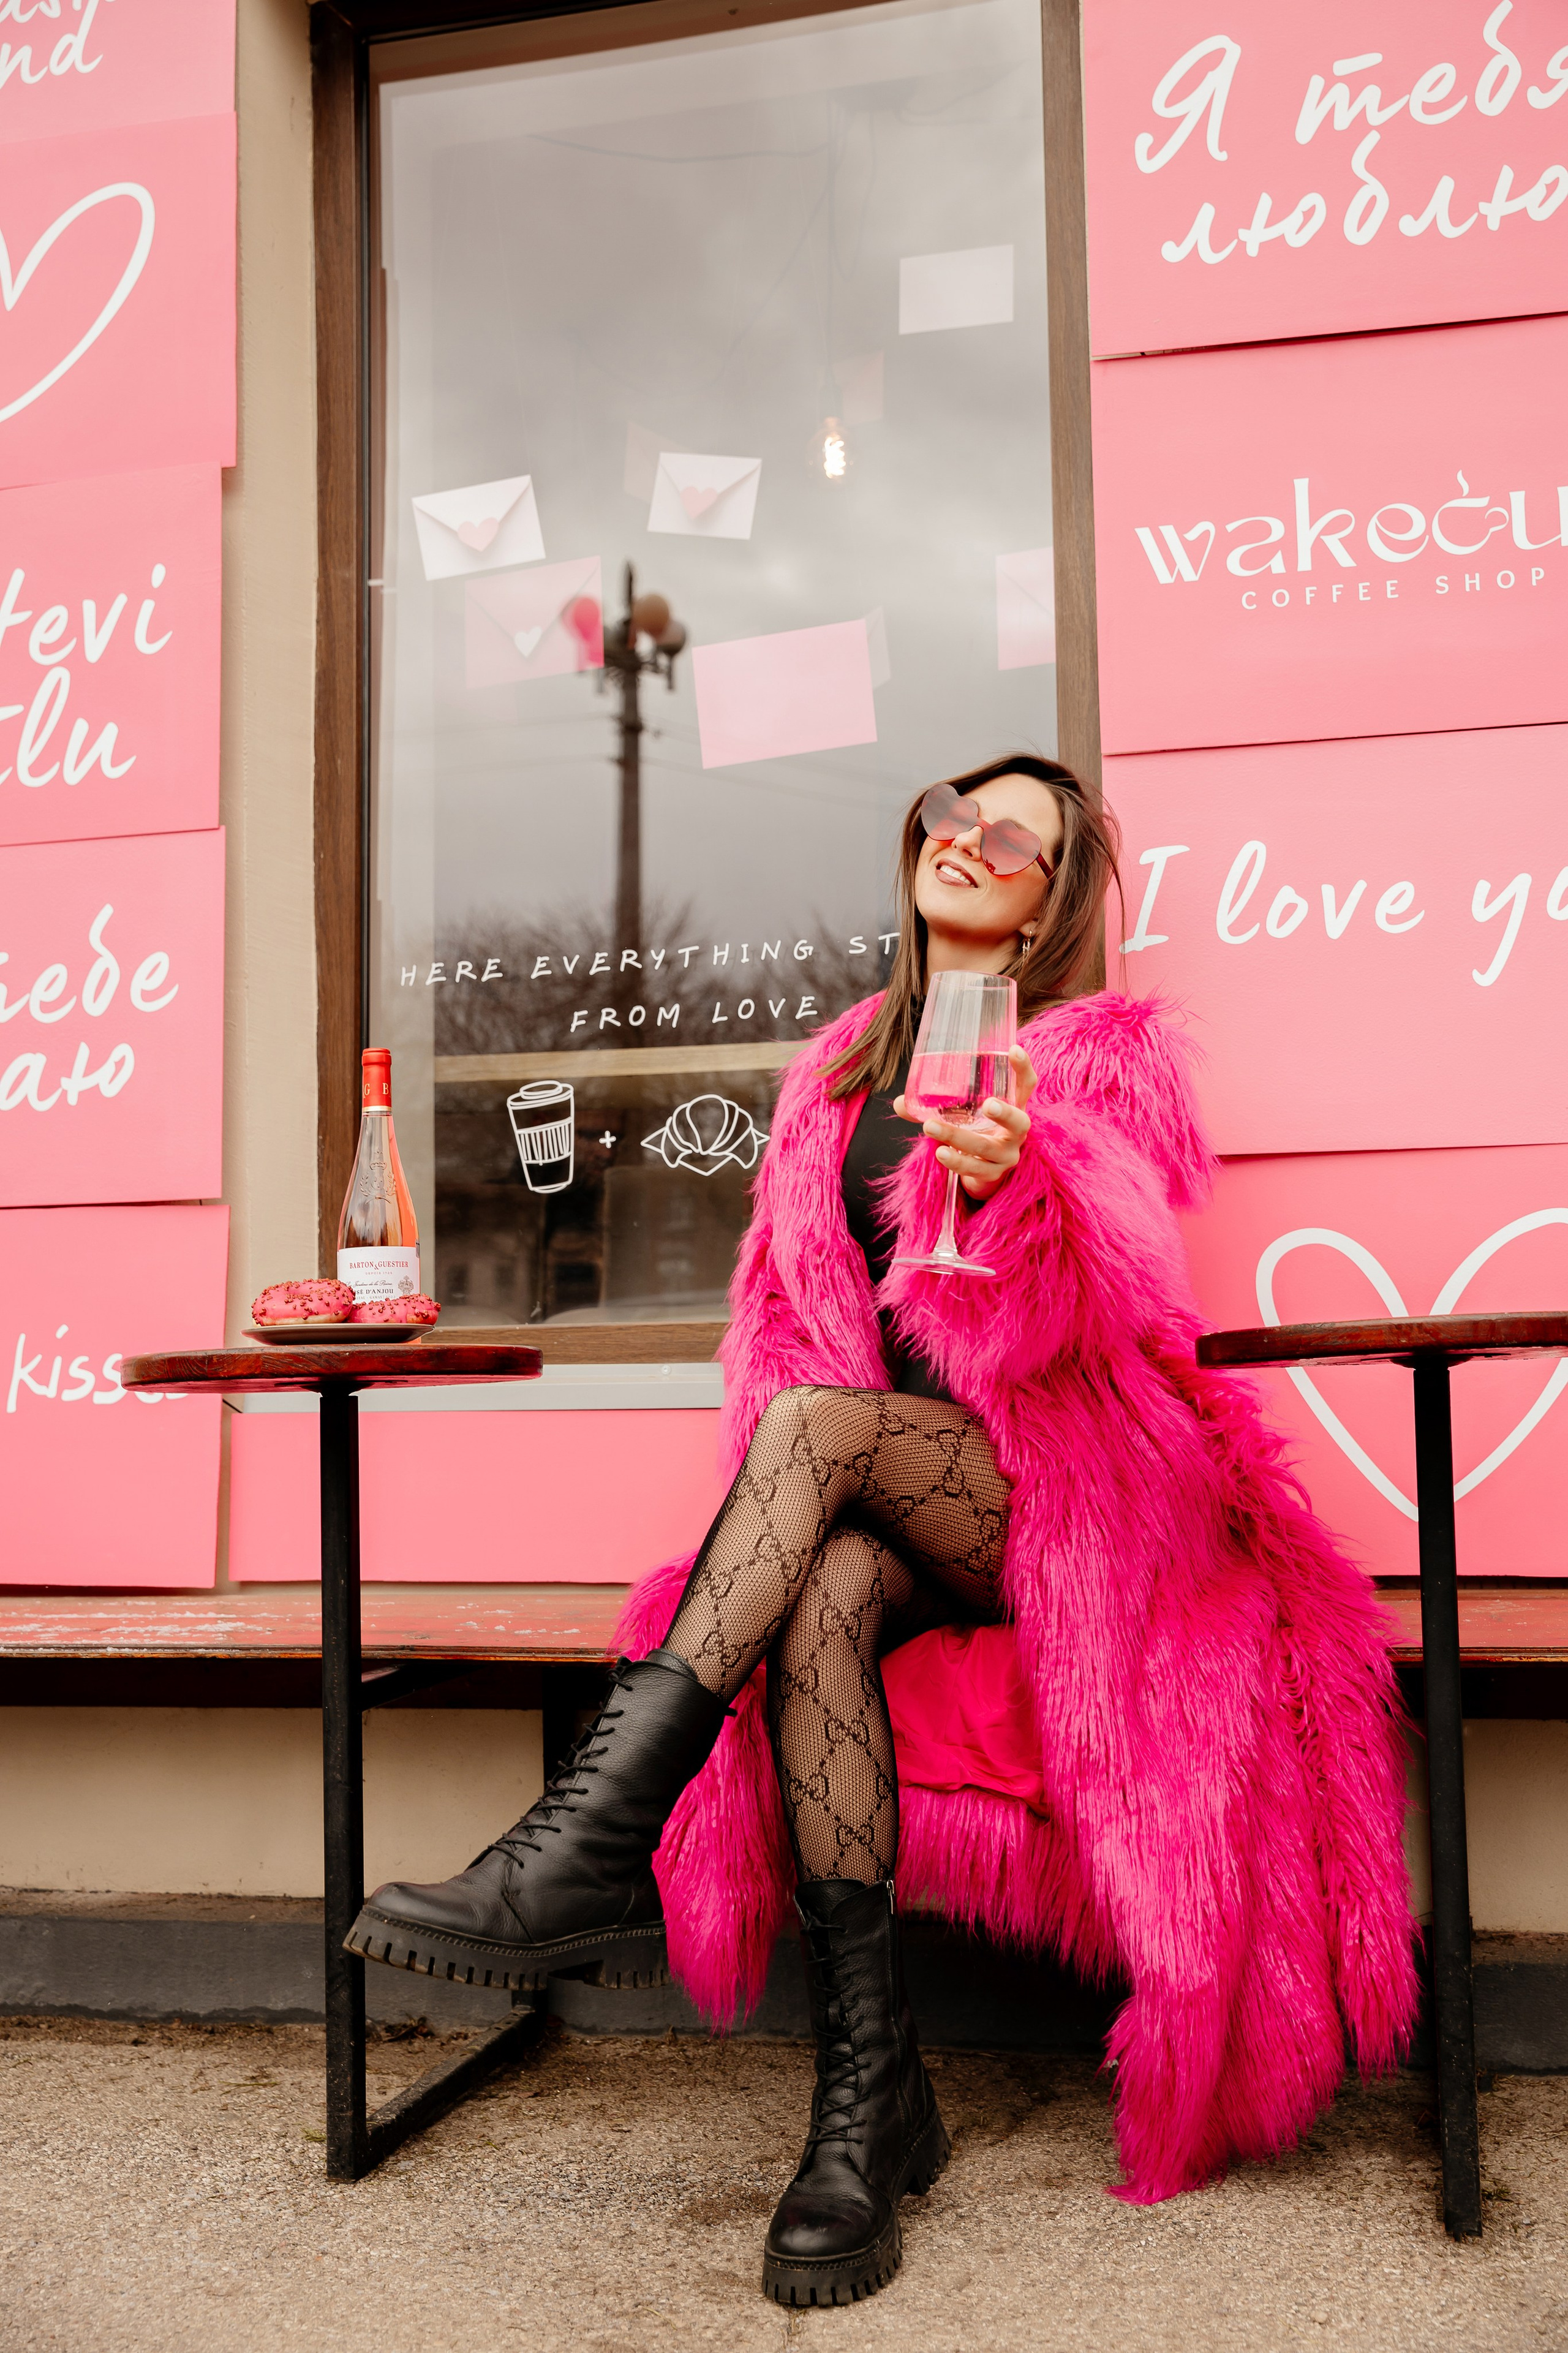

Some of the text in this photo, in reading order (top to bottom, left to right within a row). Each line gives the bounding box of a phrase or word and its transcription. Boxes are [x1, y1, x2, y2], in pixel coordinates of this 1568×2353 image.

[1134, 34, 1242, 174] Я
[1161, 129, 1568, 265] люблю
[1240, 567, 1545, 611] COFFEE SHOP
[0, 666, 137, 788] lu
[1119, 844, 1191, 954] I
[1215, 839, 1425, 945] love
[0, 903, 179, 1024] ебе
[400, 957, 503, 987] HERE
[530, 939, 815, 980] EVERYTHING
[569, 995, 818, 1033] FROM LOVE
[7, 1324, 189, 1413] kiss
